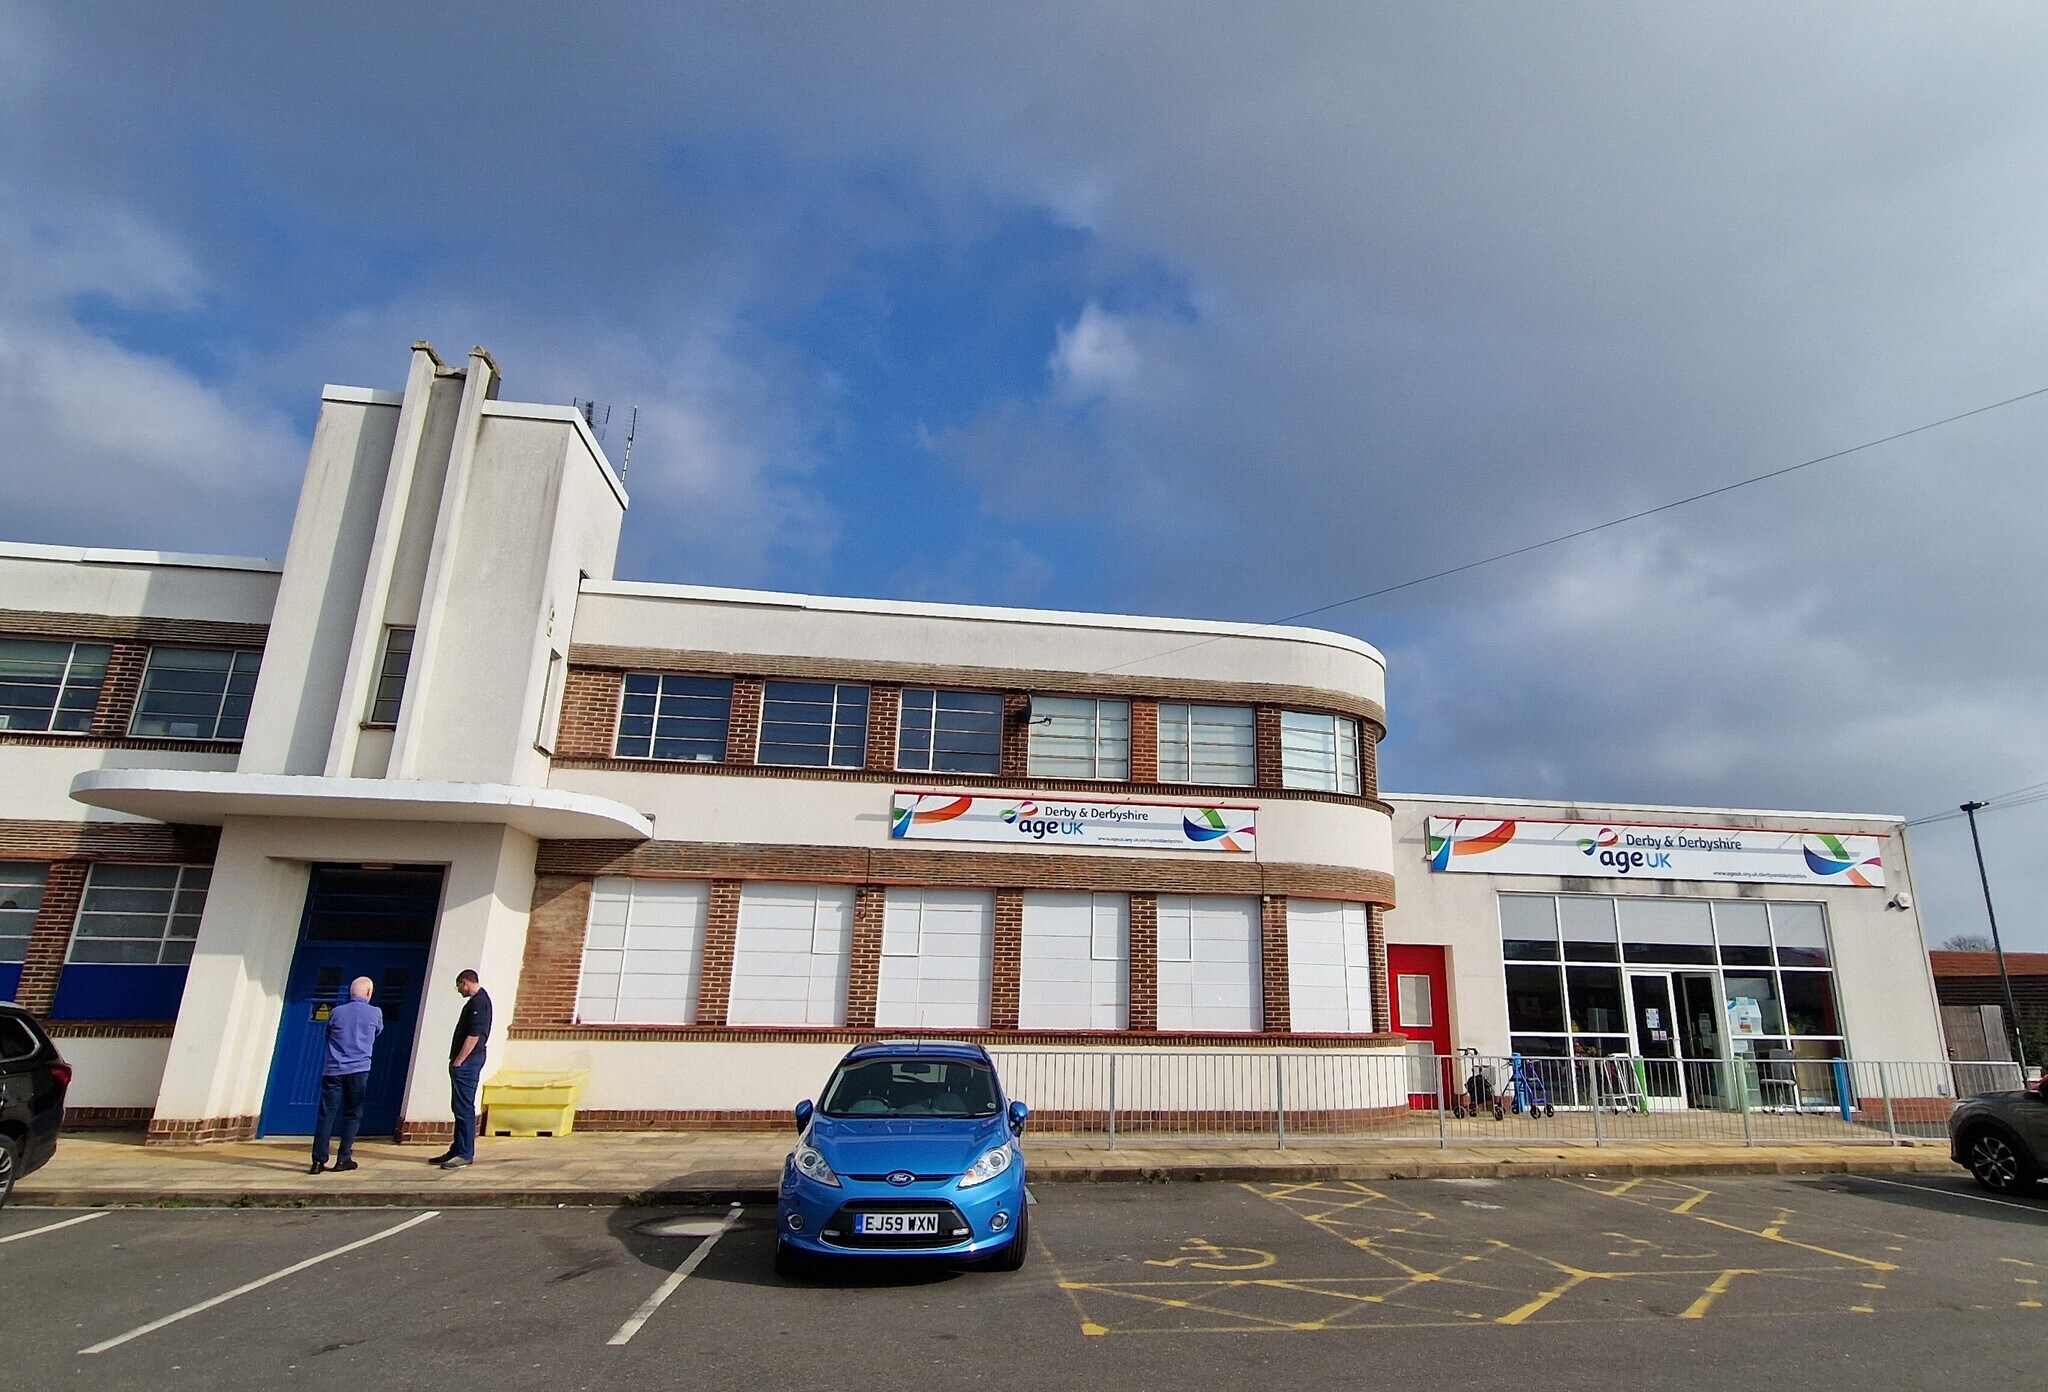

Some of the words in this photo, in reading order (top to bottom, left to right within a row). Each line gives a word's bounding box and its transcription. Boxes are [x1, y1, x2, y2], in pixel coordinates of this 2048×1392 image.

[1045, 806, 1077, 820] Derby
[1079, 808, 1088, 818] &
[1091, 807, 1149, 822] Derbyshire
[1018, 819, 1059, 839] age
[1061, 822, 1084, 835] UK
[1626, 834, 1661, 848] Derby
[1664, 836, 1674, 847] &
[1678, 836, 1742, 851] Derbyshire
[1599, 850, 1644, 873] age
[1646, 852, 1672, 868] UK
[865, 1216, 904, 1232] EJ59
[908, 1216, 936, 1232] WXN
